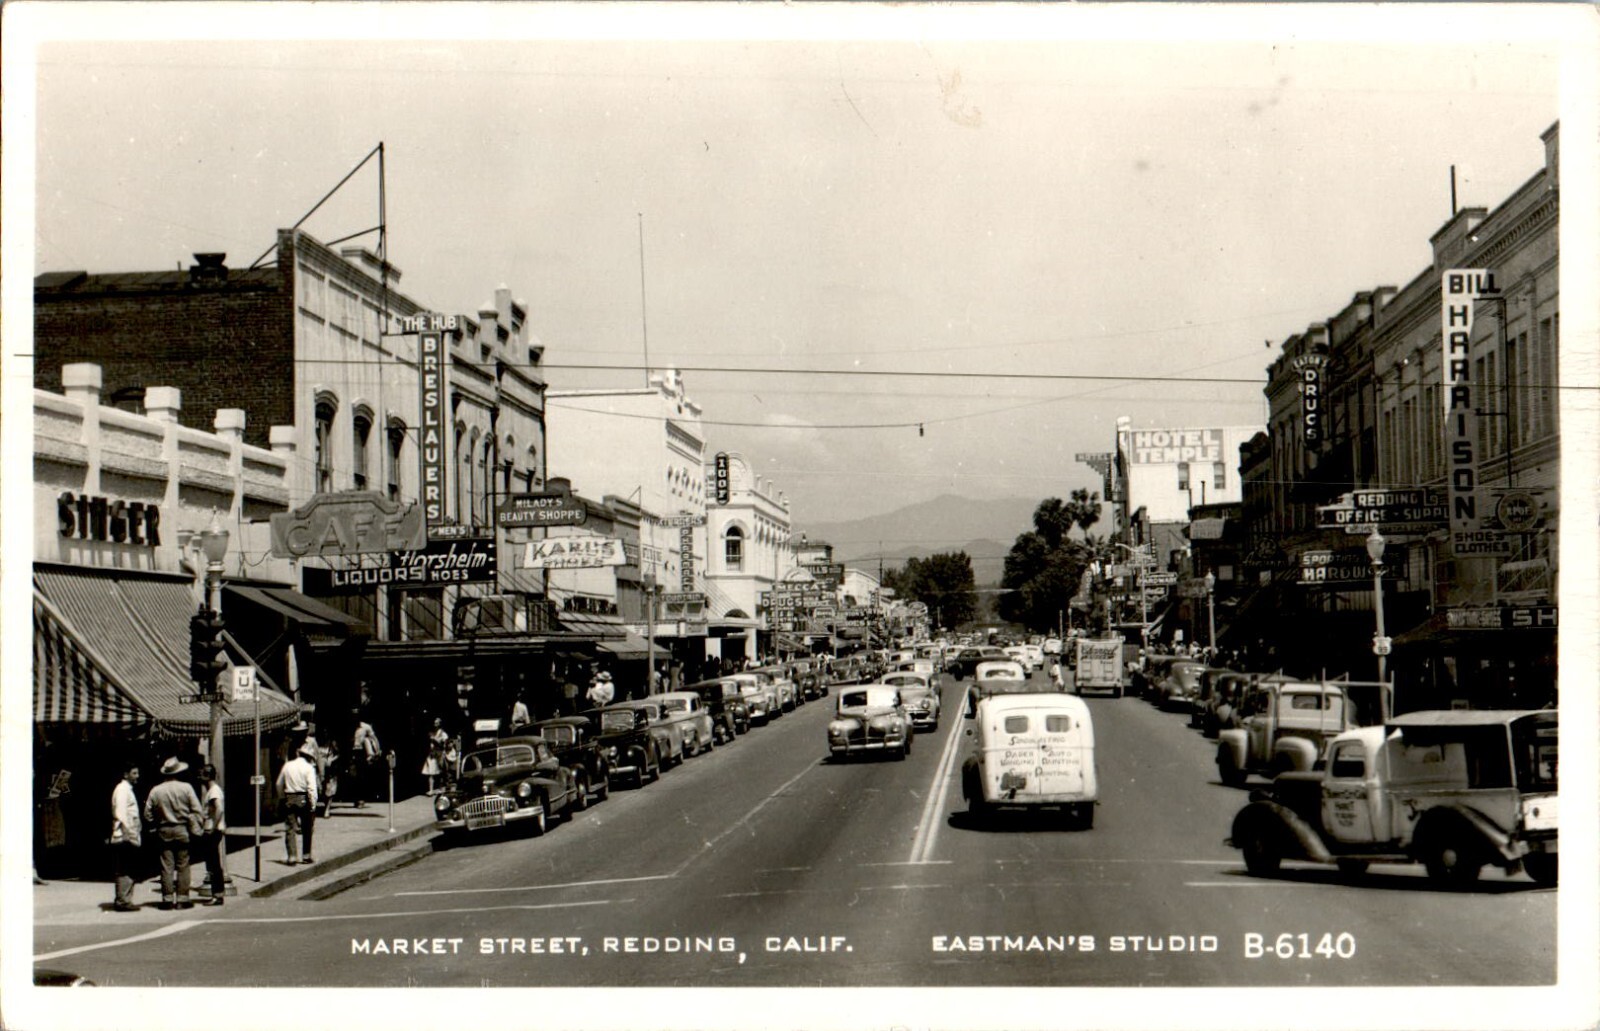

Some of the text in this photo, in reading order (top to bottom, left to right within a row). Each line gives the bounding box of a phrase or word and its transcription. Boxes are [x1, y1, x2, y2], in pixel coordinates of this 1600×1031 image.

[1449, 273, 1501, 294] BILL
[402, 316, 457, 331] THE HUB
[1304, 369, 1318, 440] DRUGS
[1449, 305, 1475, 520] HARRISON
[423, 337, 439, 520] BRESLAUERS
[1136, 430, 1220, 448] HOTEL
[1136, 447, 1220, 463] TEMPLE
[515, 498, 563, 508] MILADY'S
[1357, 492, 1418, 507] REDDING
[57, 491, 161, 546] SINGER
[500, 510, 581, 522] BEAUTY SHOPPE
[1335, 507, 1450, 523] OFFICE SUPPL
[286, 513, 409, 557] CAFE
[437, 526, 466, 536] MEN'S
[1454, 531, 1505, 542] SHOES
[1454, 542, 1510, 554] CLOTHES
[334, 567, 424, 586] LIQUORS
[431, 569, 469, 581] HOES
[762, 598, 802, 607] DRUGS
[238, 676, 250, 687] U
